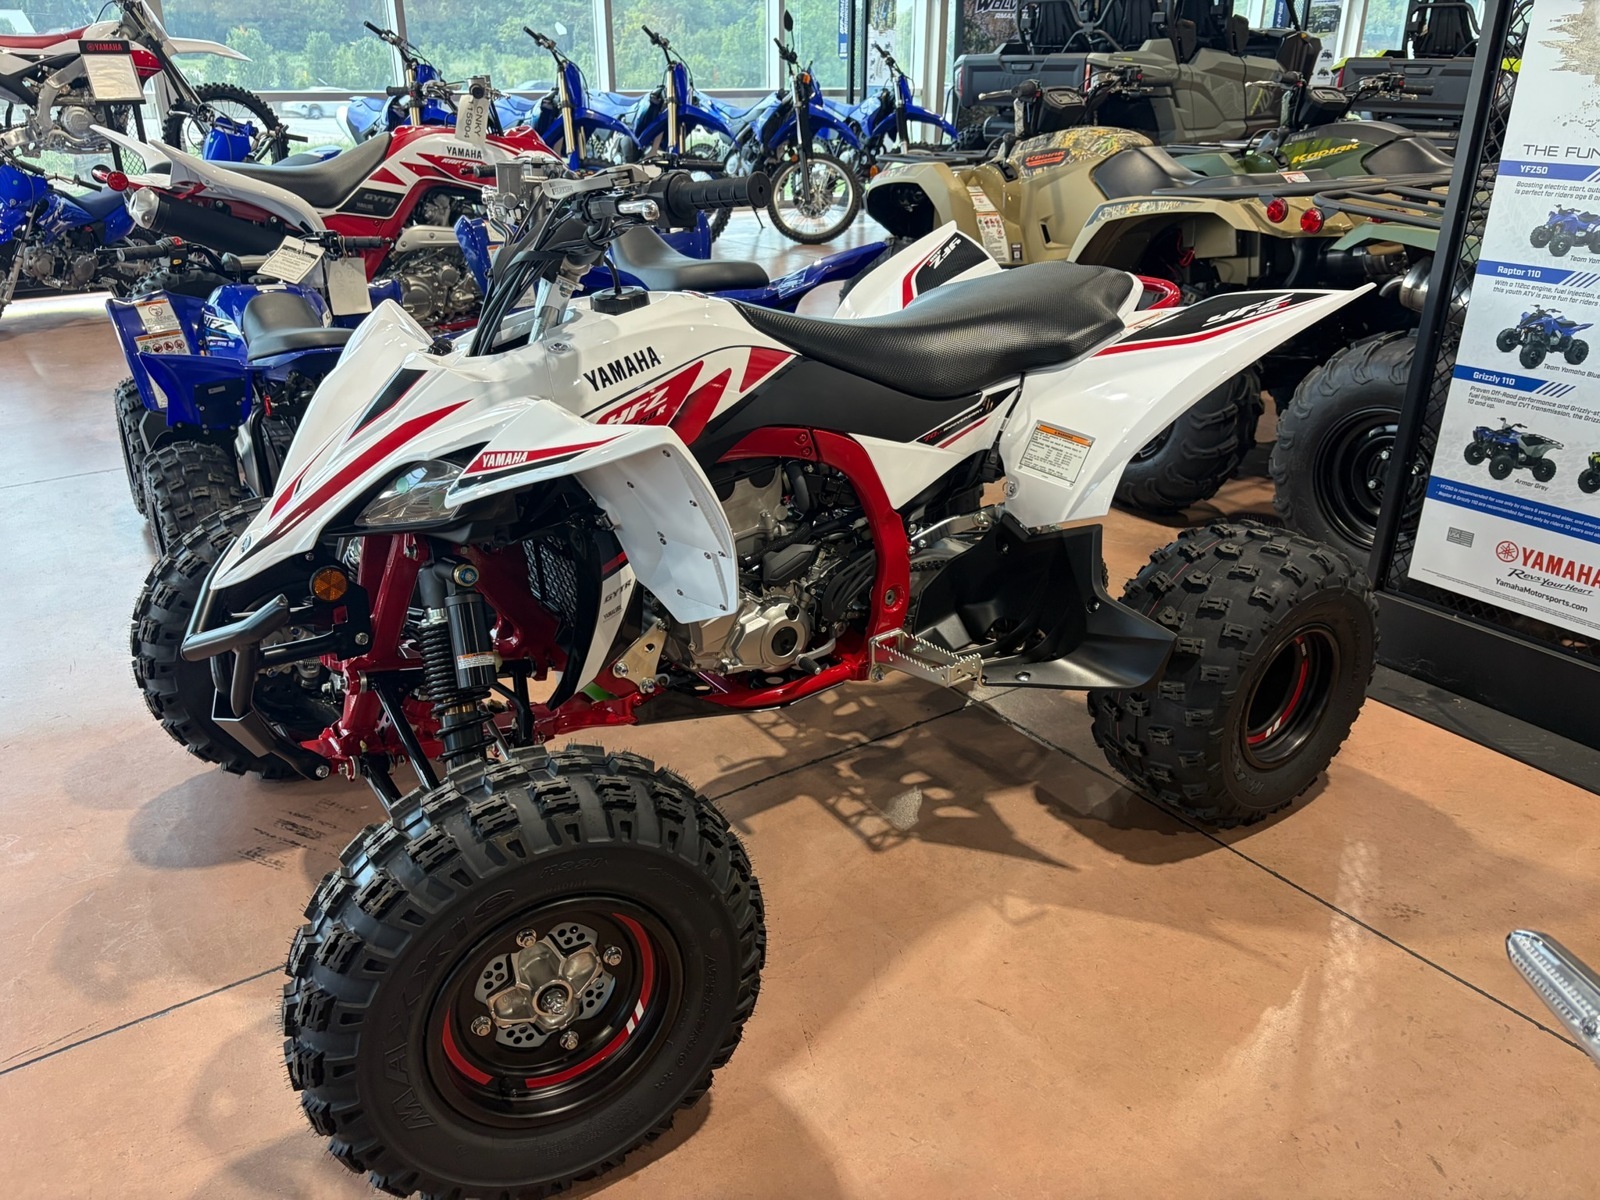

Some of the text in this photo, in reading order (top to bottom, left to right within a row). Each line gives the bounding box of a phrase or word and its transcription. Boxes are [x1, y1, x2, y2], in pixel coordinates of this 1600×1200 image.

[94, 43, 122, 51] YAMAHA
[474, 106, 484, 137] CNKY
[446, 146, 482, 160] YAMAHA
[1291, 142, 1360, 164] KODIAK
[1523, 144, 1560, 157] THE
[1520, 164, 1548, 174] YFZ50
[1516, 181, 1544, 190] Boasting
[1544, 183, 1568, 191] electric
[1520, 189, 1544, 197] perfect
[364, 193, 397, 204] GYTR
[1497, 265, 1542, 278] Raptor 110
[1504, 288, 1522, 296] youth
[1522, 290, 1536, 298] ATV
[1541, 294, 1556, 302] pure
[1580, 298, 1598, 306] riders
[1515, 282, 1530, 290] 112cc
[1530, 285, 1552, 294] engine,
[1567, 289, 1596, 300] injection,
[1201, 292, 1294, 328] YFZ
[583, 346, 662, 392] YAMAHA
[1561, 366, 1586, 376] Yamaha
[1473, 372, 1516, 386] Grizzly 110
[1470, 386, 1490, 394] Proven
[1490, 390, 1518, 400] Off-Road
[1518, 394, 1557, 408] performance
[1570, 405, 1600, 418] Grizzly-st
[1480, 394, 1506, 405] injection
[1531, 404, 1572, 418] transmission,
[482, 452, 528, 468] YAMAHA
[1514, 478, 1534, 487] Armor
[1522, 546, 1600, 590] YAMAHA
[1507, 567, 1594, 597] Revs Your Heart
[604, 579, 632, 604] GYTR
[1496, 578, 1588, 612] YamahaMotorsports.com
[384, 889, 516, 1130] MAXXIS
